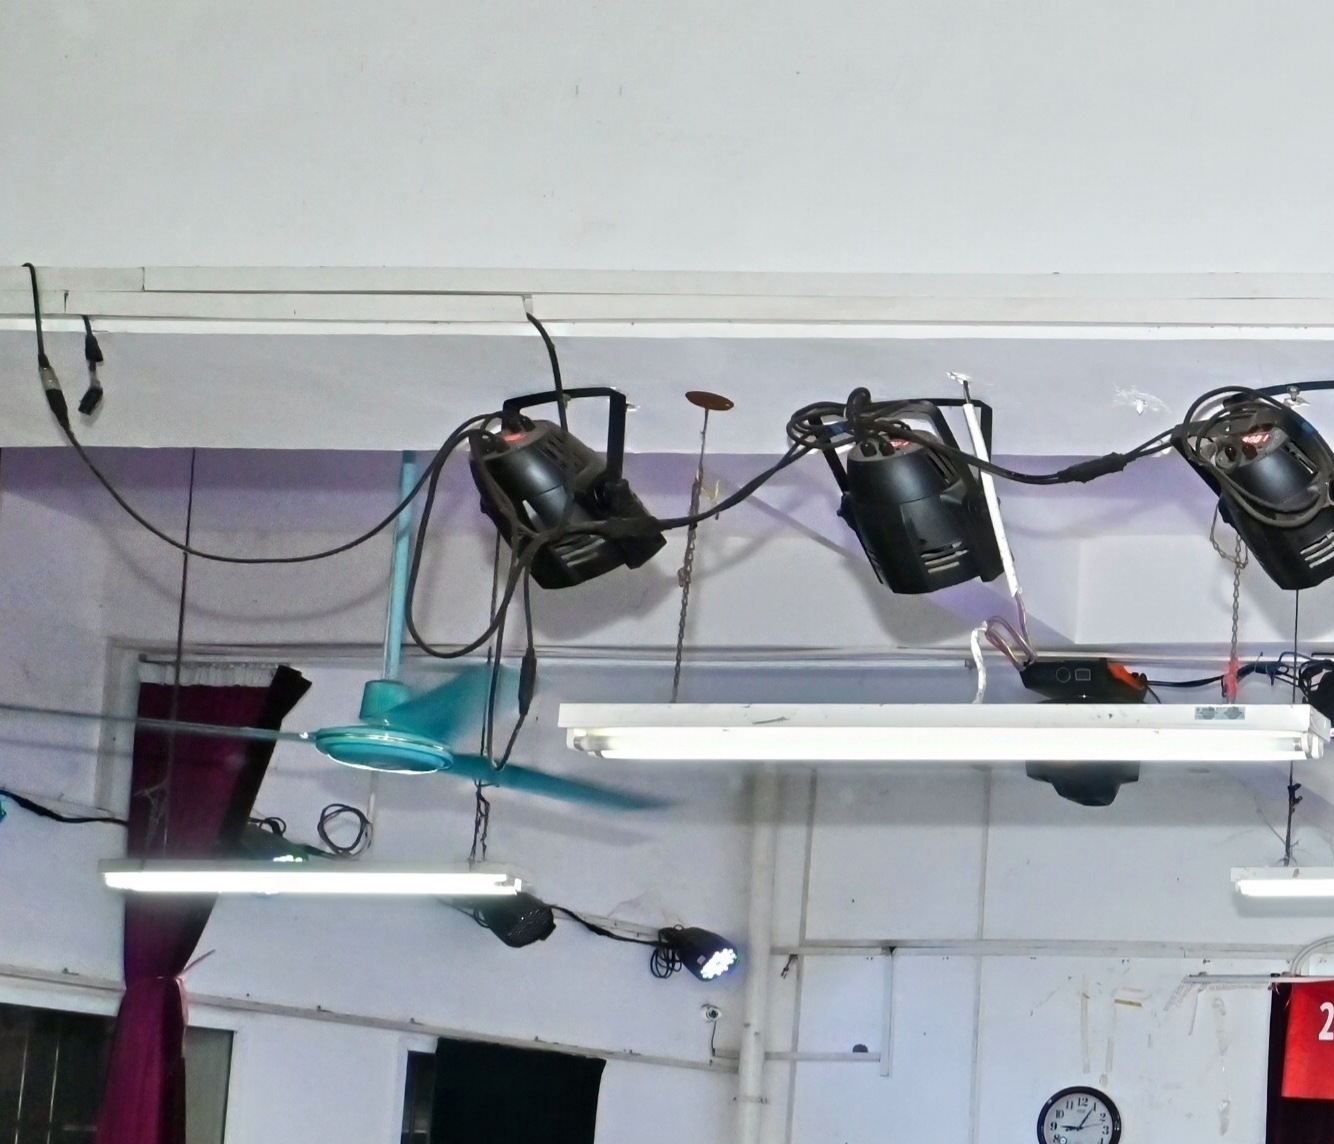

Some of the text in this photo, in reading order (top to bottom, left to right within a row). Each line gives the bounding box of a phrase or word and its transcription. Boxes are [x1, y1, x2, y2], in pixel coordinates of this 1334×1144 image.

[1066, 1100, 1074, 1110] 11
[1077, 1097, 1089, 1107] 12
[1055, 1109, 1065, 1119] 10
[1050, 1121, 1058, 1131] 9
[1102, 1125, 1110, 1136] 3
